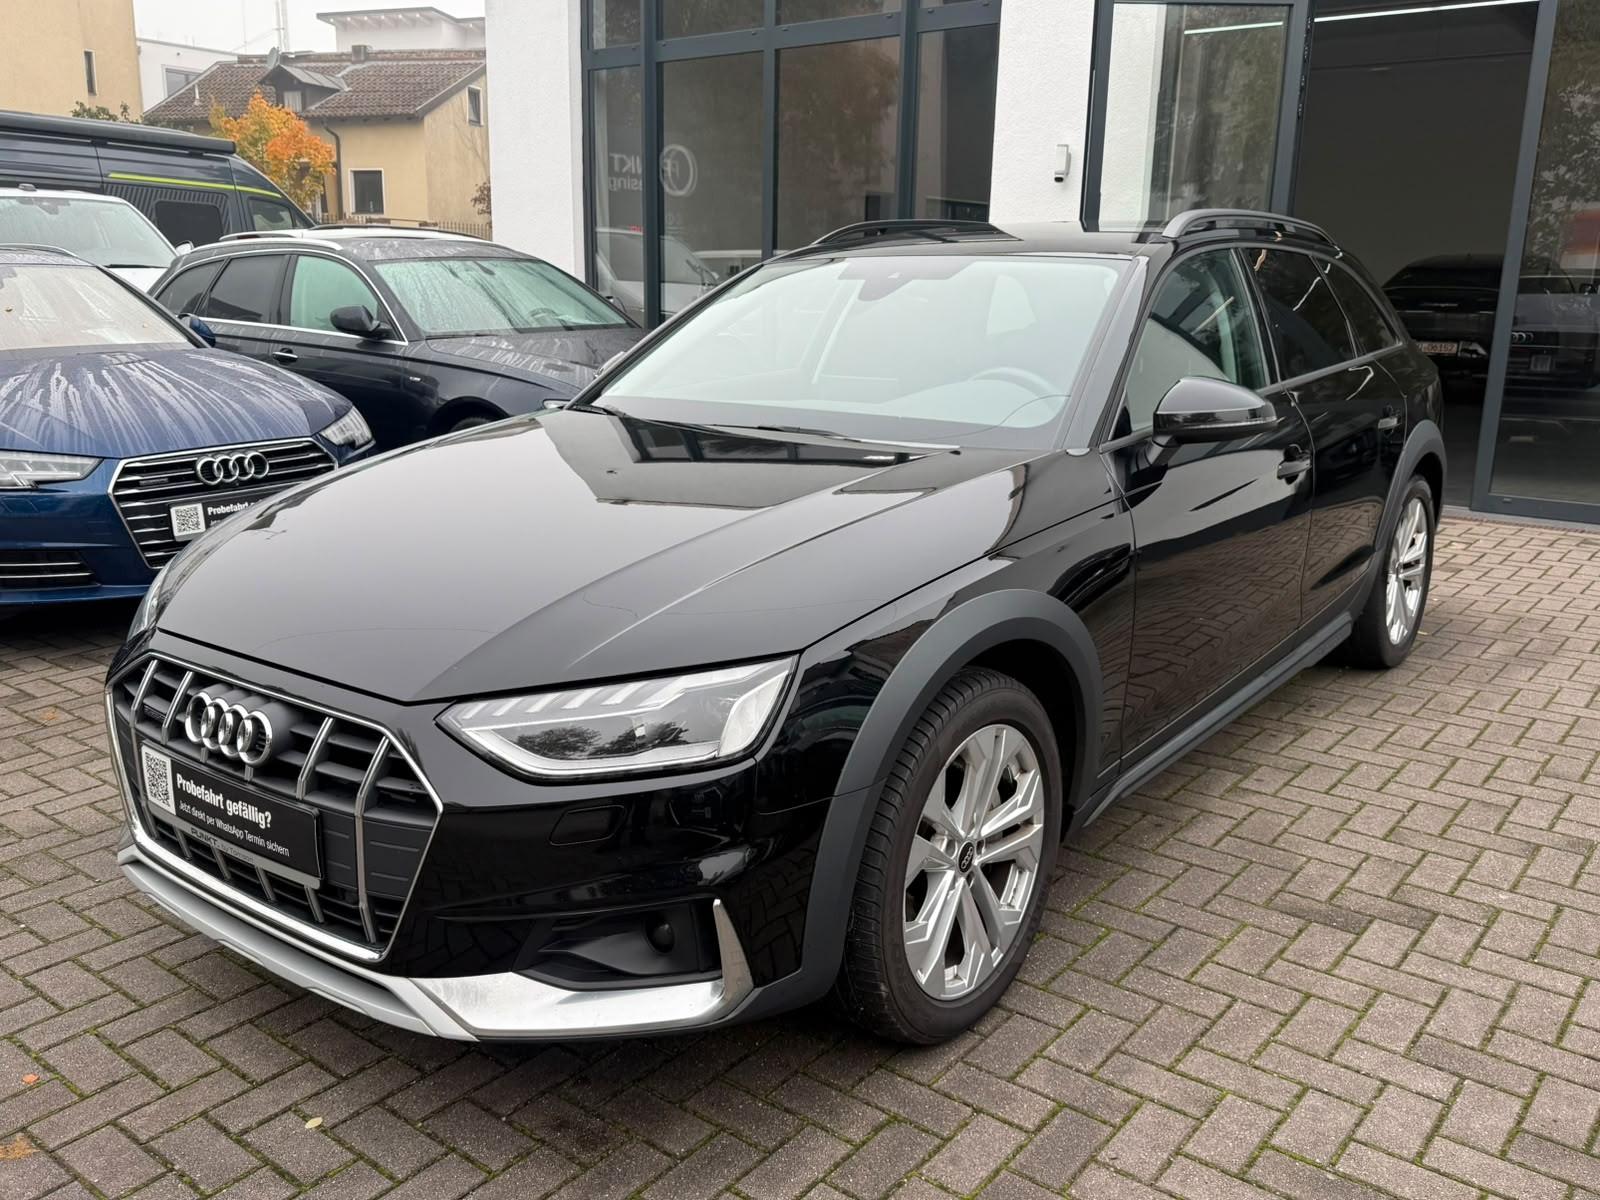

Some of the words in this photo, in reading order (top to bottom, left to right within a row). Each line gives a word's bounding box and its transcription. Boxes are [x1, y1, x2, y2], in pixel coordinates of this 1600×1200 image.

[176, 773, 224, 809] Probefahrt
[226, 799, 272, 829] gefällig?
[180, 800, 191, 814] Jetzt
[191, 806, 206, 822] direkt
[206, 815, 215, 826] per
[215, 818, 244, 839] WhatsApp
[244, 829, 266, 848] Termin
[266, 840, 290, 857] sichern
